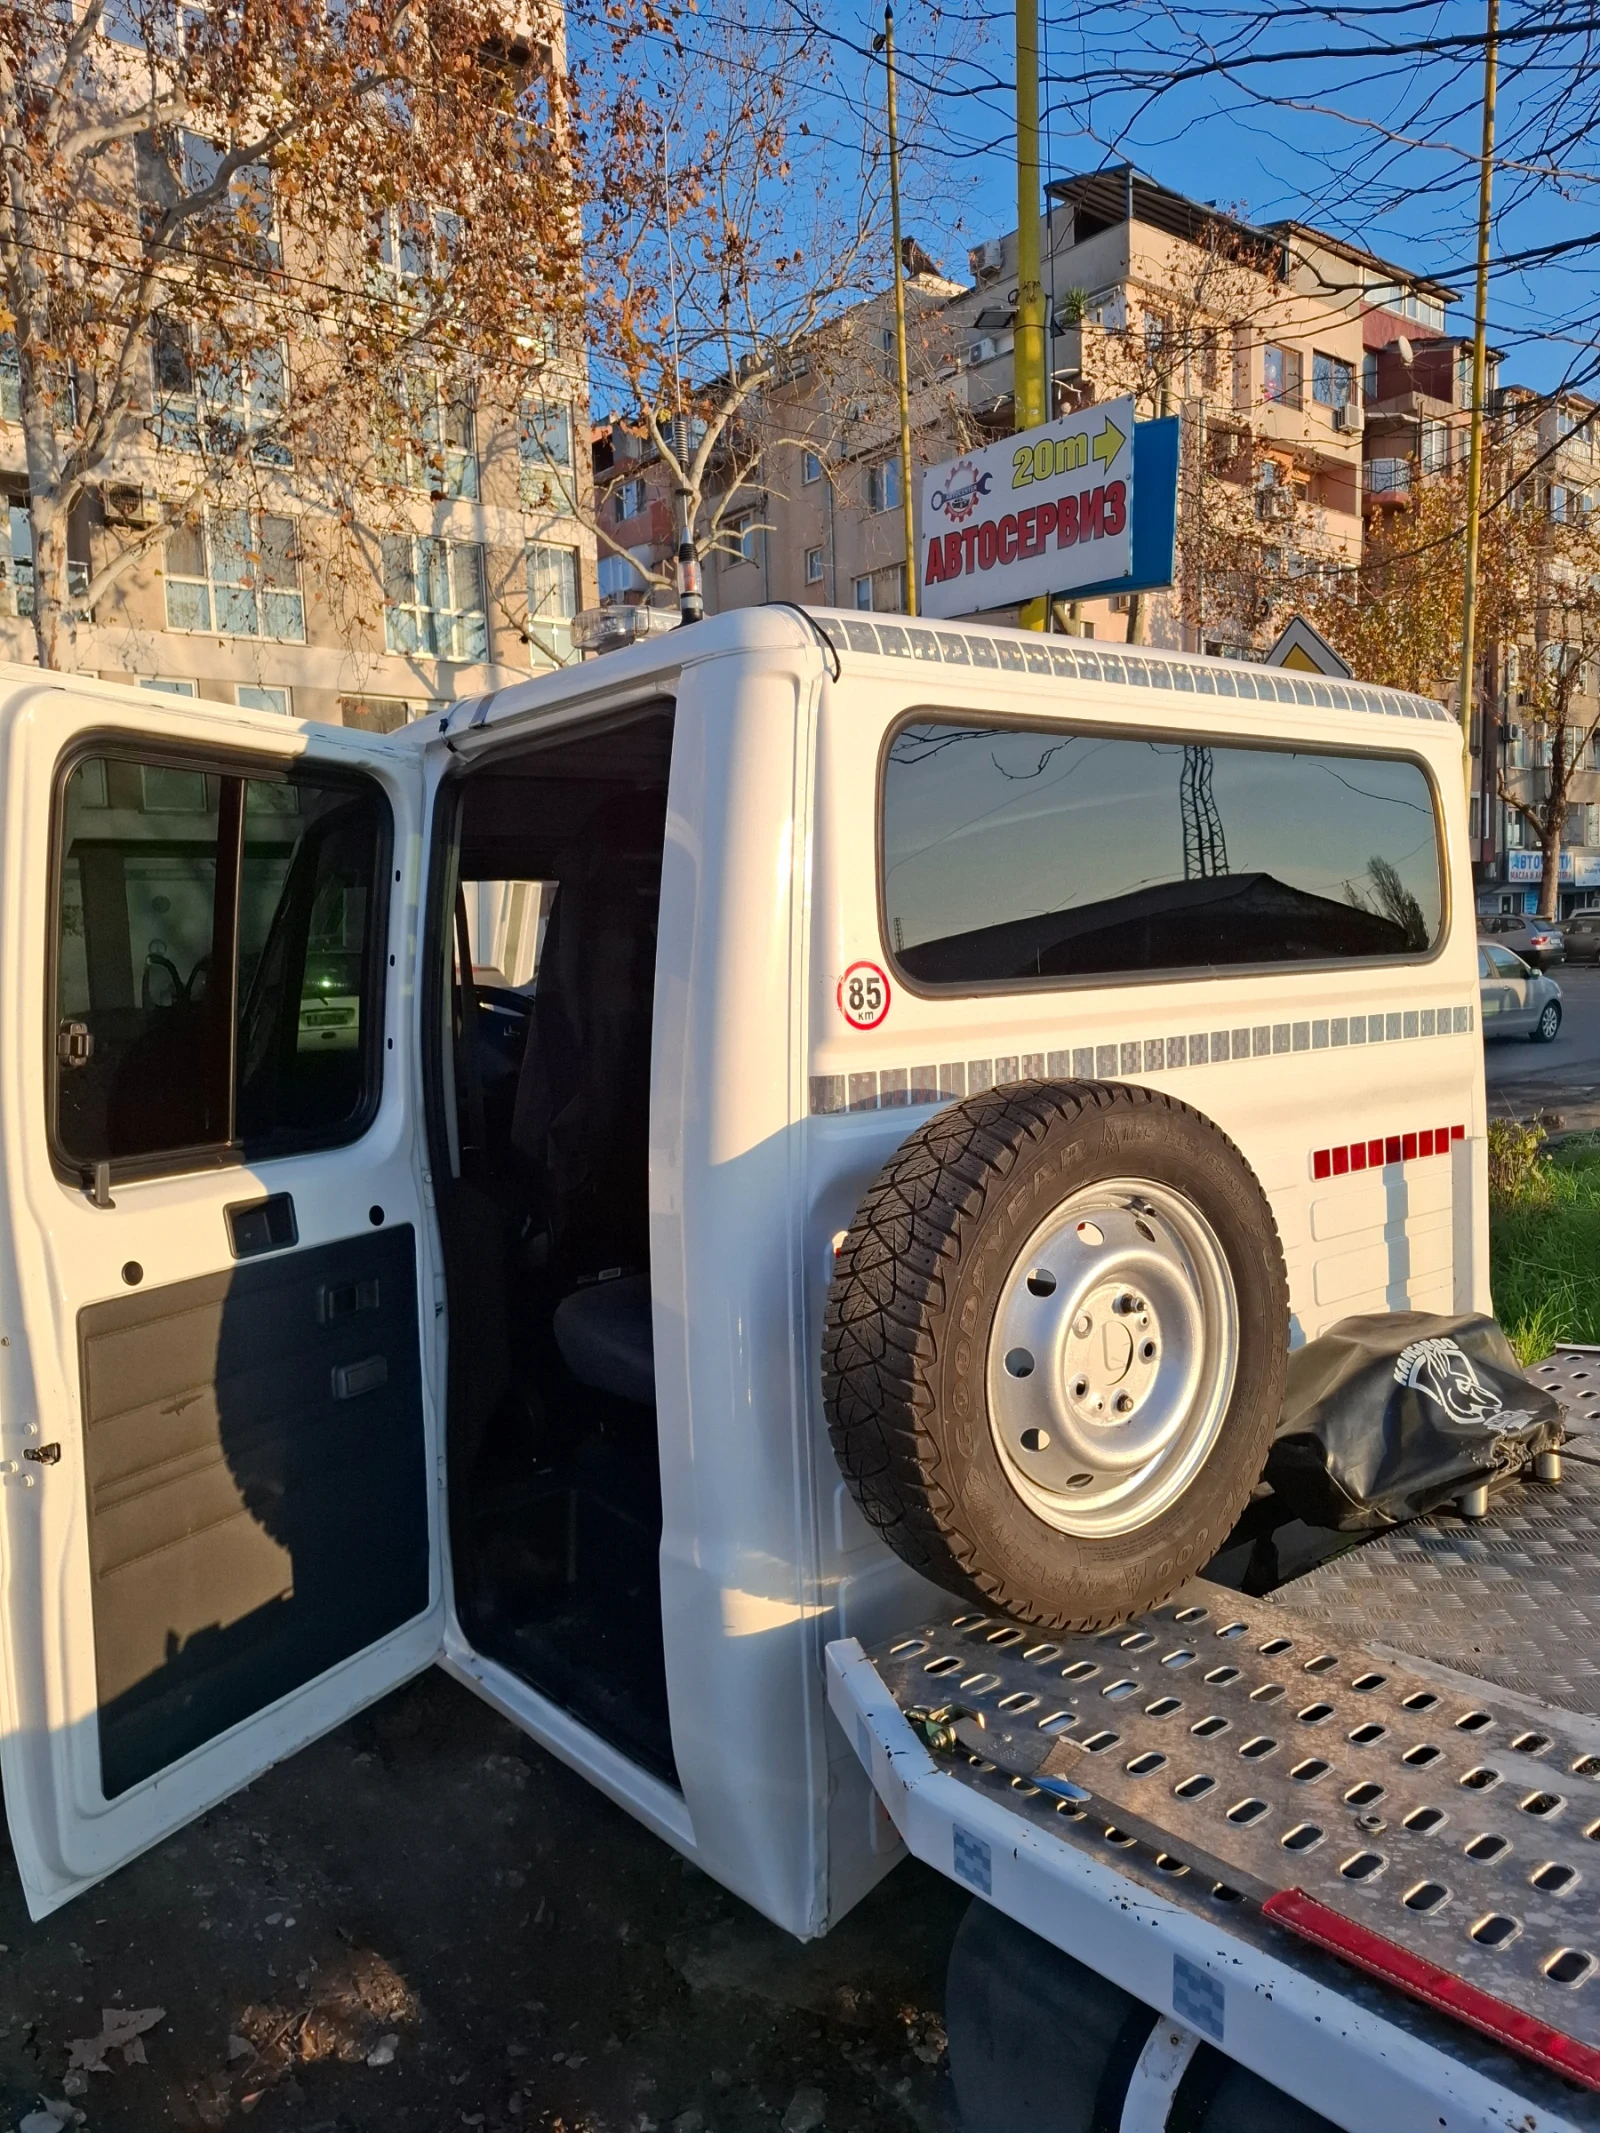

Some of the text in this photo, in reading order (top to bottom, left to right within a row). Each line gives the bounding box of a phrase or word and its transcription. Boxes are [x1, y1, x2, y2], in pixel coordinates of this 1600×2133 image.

[925, 480, 1127, 586] АВТОСЕРВИЗ
[849, 977, 881, 1011] 85
[1393, 1337, 1460, 1387] KANGAROO
